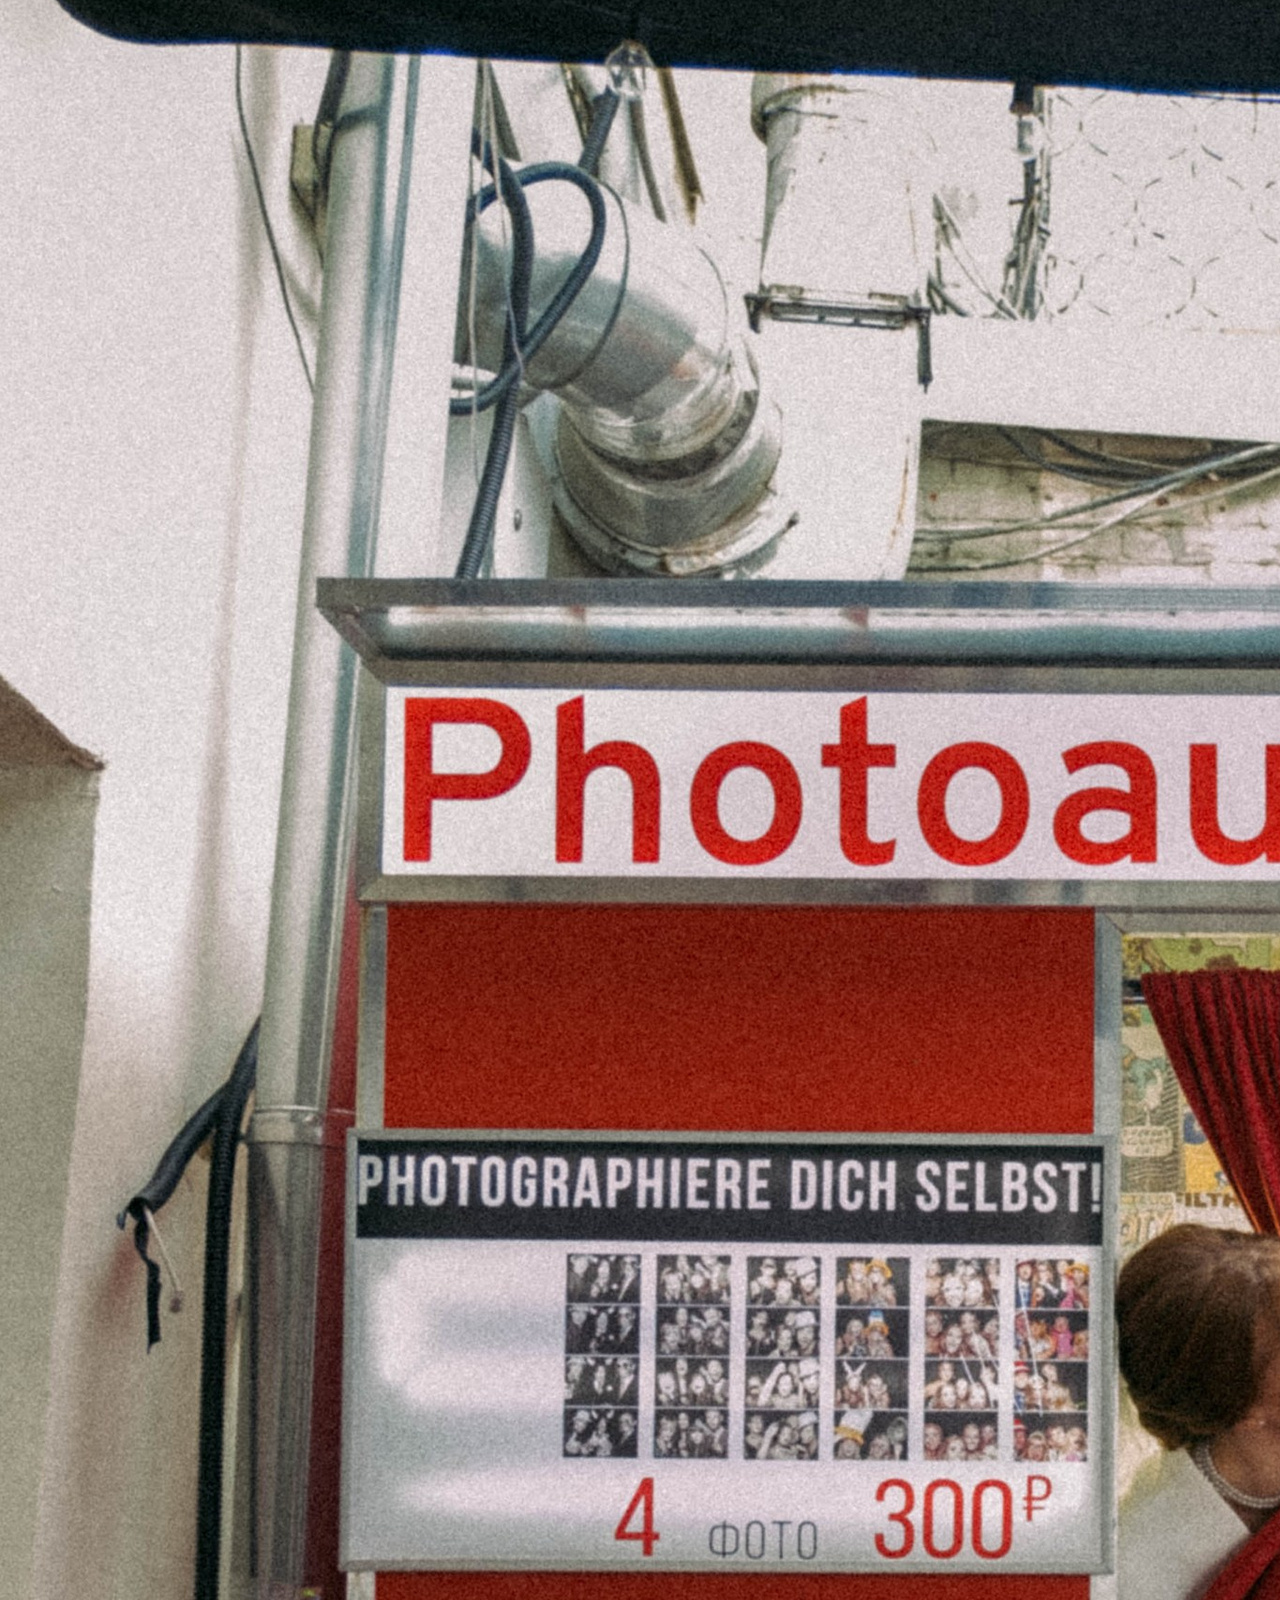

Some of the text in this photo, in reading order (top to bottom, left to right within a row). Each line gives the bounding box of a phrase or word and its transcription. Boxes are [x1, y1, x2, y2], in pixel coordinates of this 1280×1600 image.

[358, 1153, 1102, 1214] PHOTOGRAPHIERE DICH SELBST!
[614, 1476, 660, 1557] 4
